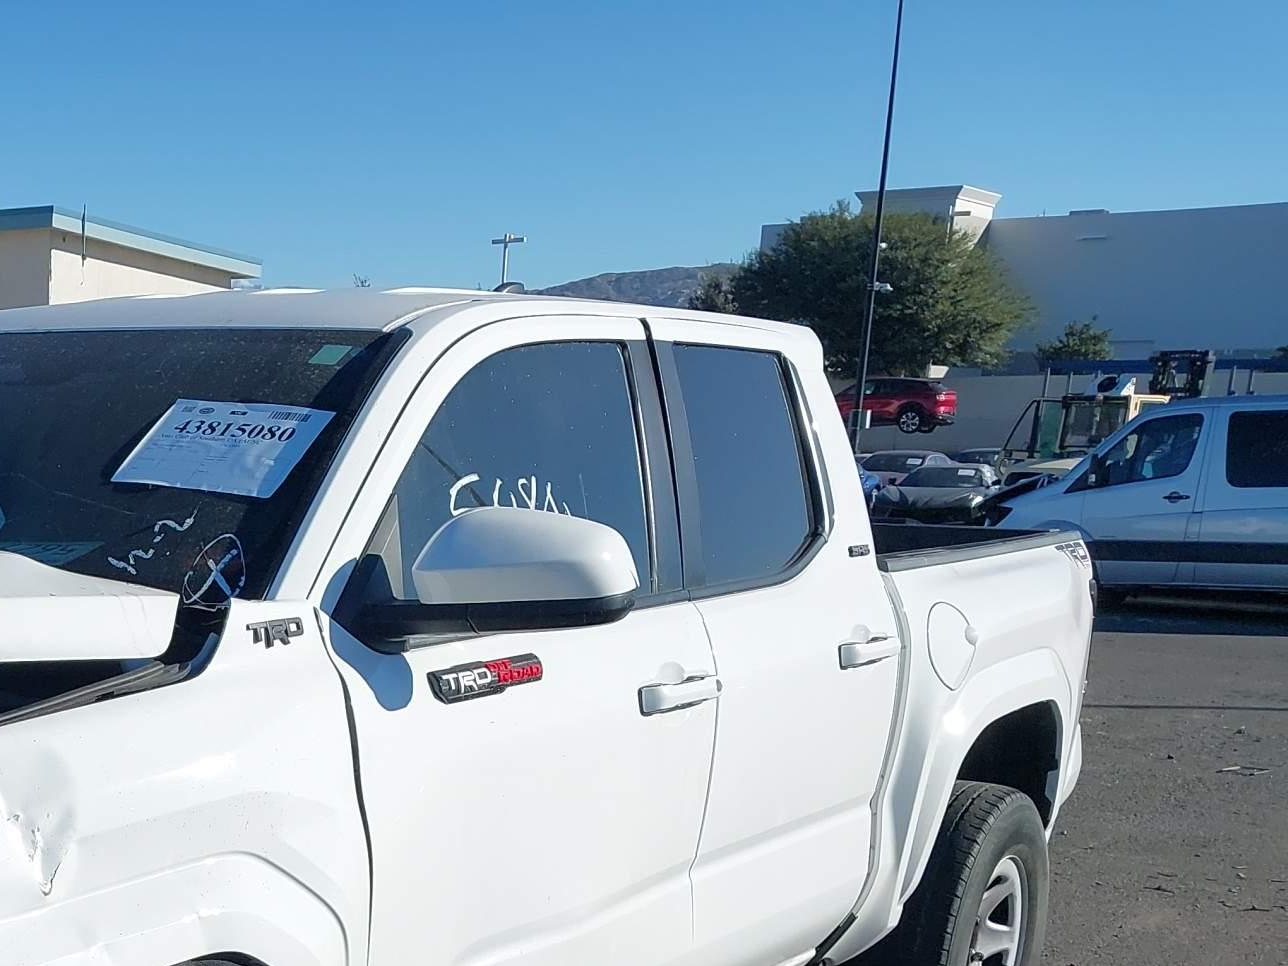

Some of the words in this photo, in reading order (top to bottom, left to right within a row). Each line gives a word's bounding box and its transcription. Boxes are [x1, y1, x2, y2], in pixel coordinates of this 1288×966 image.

[174, 419, 297, 442] 43815080
[1054, 541, 1089, 568] TRD
[245, 616, 305, 649] TRD
[440, 666, 492, 693] TRD
